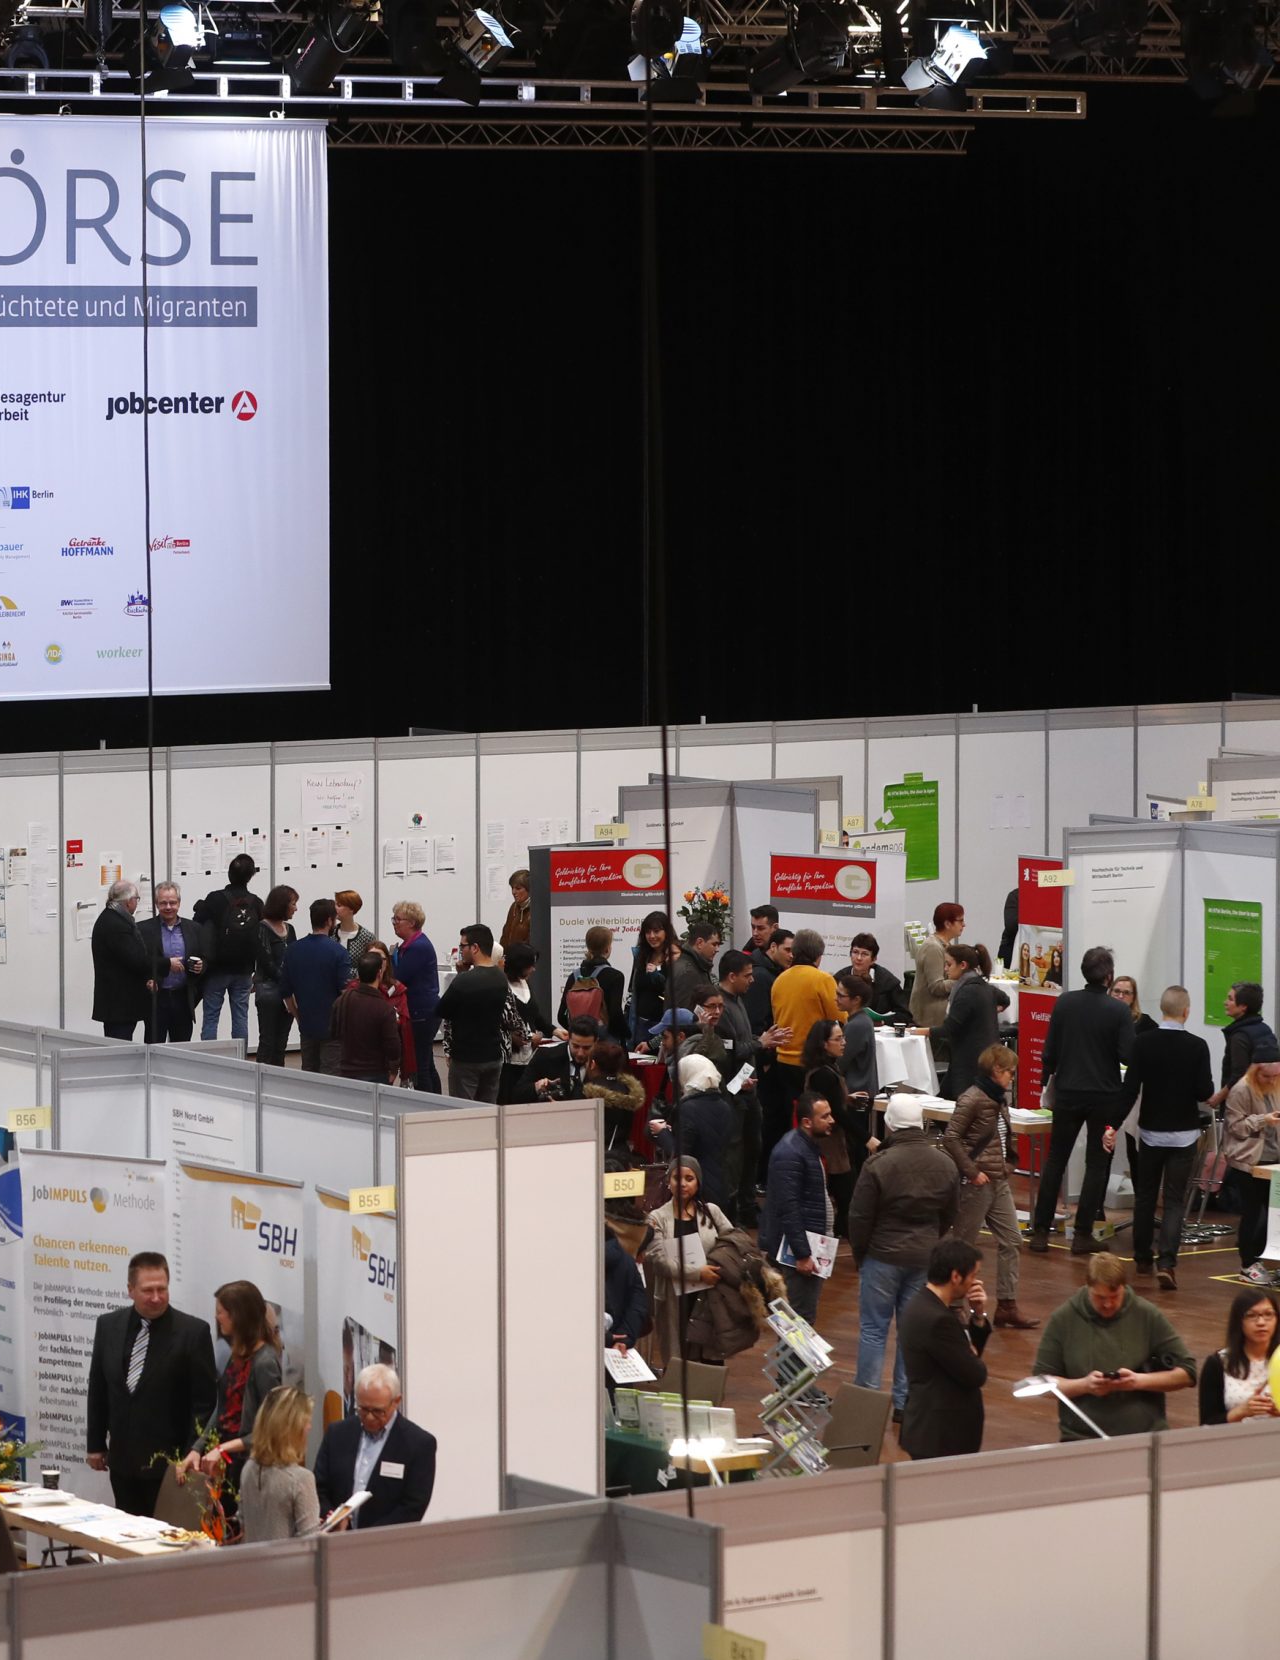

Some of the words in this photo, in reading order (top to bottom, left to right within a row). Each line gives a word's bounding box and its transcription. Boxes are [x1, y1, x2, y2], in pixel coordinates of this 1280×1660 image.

[86, 295, 126, 318] und
[134, 295, 247, 323] Migranten
[106, 392, 224, 420] jobcenter
[13, 490, 28, 499] IHK
[32, 490, 54, 499] Berlin
[61, 547, 114, 557] HOFFMANN
[96, 646, 144, 659] workeer
[600, 829, 613, 837] A94
[588, 865, 597, 873] für
[803, 872, 812, 881] für
[1044, 875, 1058, 883] A92
[560, 918, 584, 926] Duale
[16, 1114, 36, 1126] B56
[172, 1108, 184, 1119] SBH
[184, 1110, 197, 1122] Nord
[198, 1113, 214, 1125] GmbH
[614, 1179, 635, 1191] B50
[113, 1194, 155, 1211] Methode
[359, 1194, 380, 1208] B55
[258, 1221, 297, 1257] SBH
[33, 1235, 75, 1250] Chancen
[79, 1240, 130, 1256] erkennen.
[33, 1254, 69, 1268] Talente
[74, 1259, 112, 1272] nutzen.
[368, 1253, 397, 1290] SBH
[33, 1282, 43, 1291] Die
[77, 1288, 103, 1297] Methode
[105, 1290, 120, 1298] steht
[44, 1296, 72, 1307] Profiling
[73, 1298, 84, 1306] der
[85, 1300, 105, 1309] neuen
[33, 1307, 64, 1317] Persönlich
[39, 1344, 48, 1352] der
[50, 1345, 83, 1356] fachlichen
[39, 1383, 48, 1391] für
[55, 1452, 85, 1464] aktuellen
